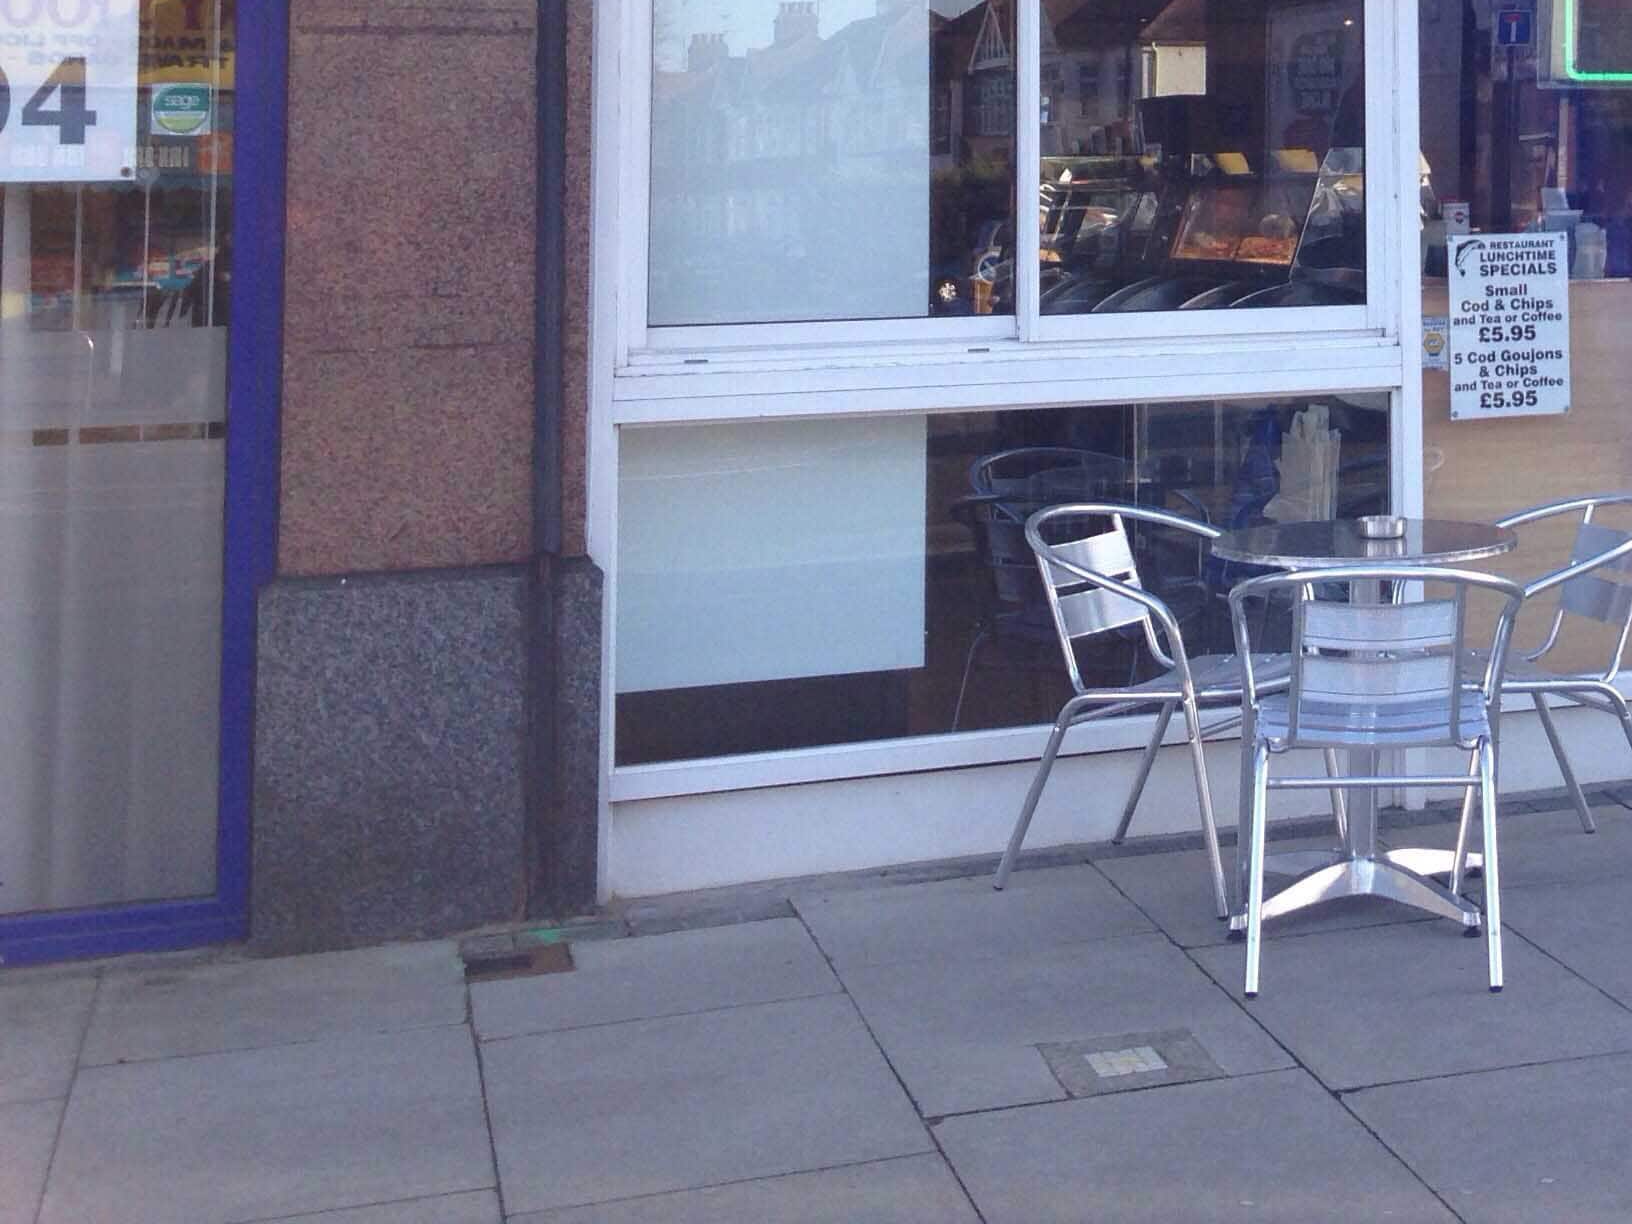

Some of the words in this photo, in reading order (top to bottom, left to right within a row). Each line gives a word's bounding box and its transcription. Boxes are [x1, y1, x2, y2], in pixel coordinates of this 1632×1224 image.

[164, 95, 200, 110] sage
[1490, 240, 1554, 249] RESTAURANT
[1480, 250, 1556, 262] LUNCHTIME
[1480, 262, 1557, 277] SPECIALS
[1485, 283, 1527, 297] Small
[1461, 299, 1489, 313] Cod
[1494, 299, 1505, 312] &
[1510, 297, 1554, 312] Chips
[1453, 315, 1476, 326] and
[1480, 314, 1501, 324] Tea
[1505, 314, 1518, 323] or
[1521, 312, 1562, 322] Coffee
[1479, 325, 1537, 343] £5.95
[1454, 353, 1463, 365] 5
[1467, 351, 1496, 364] Cod
[1500, 348, 1563, 363] Goujons
[1479, 365, 1489, 378] &
[1495, 363, 1538, 378] Chips
[1454, 381, 1477, 392] and
[1480, 380, 1502, 390] Tea
[1506, 380, 1519, 389] or
[1522, 376, 1564, 388] Coffee
[1480, 390, 1538, 408] £5.95
